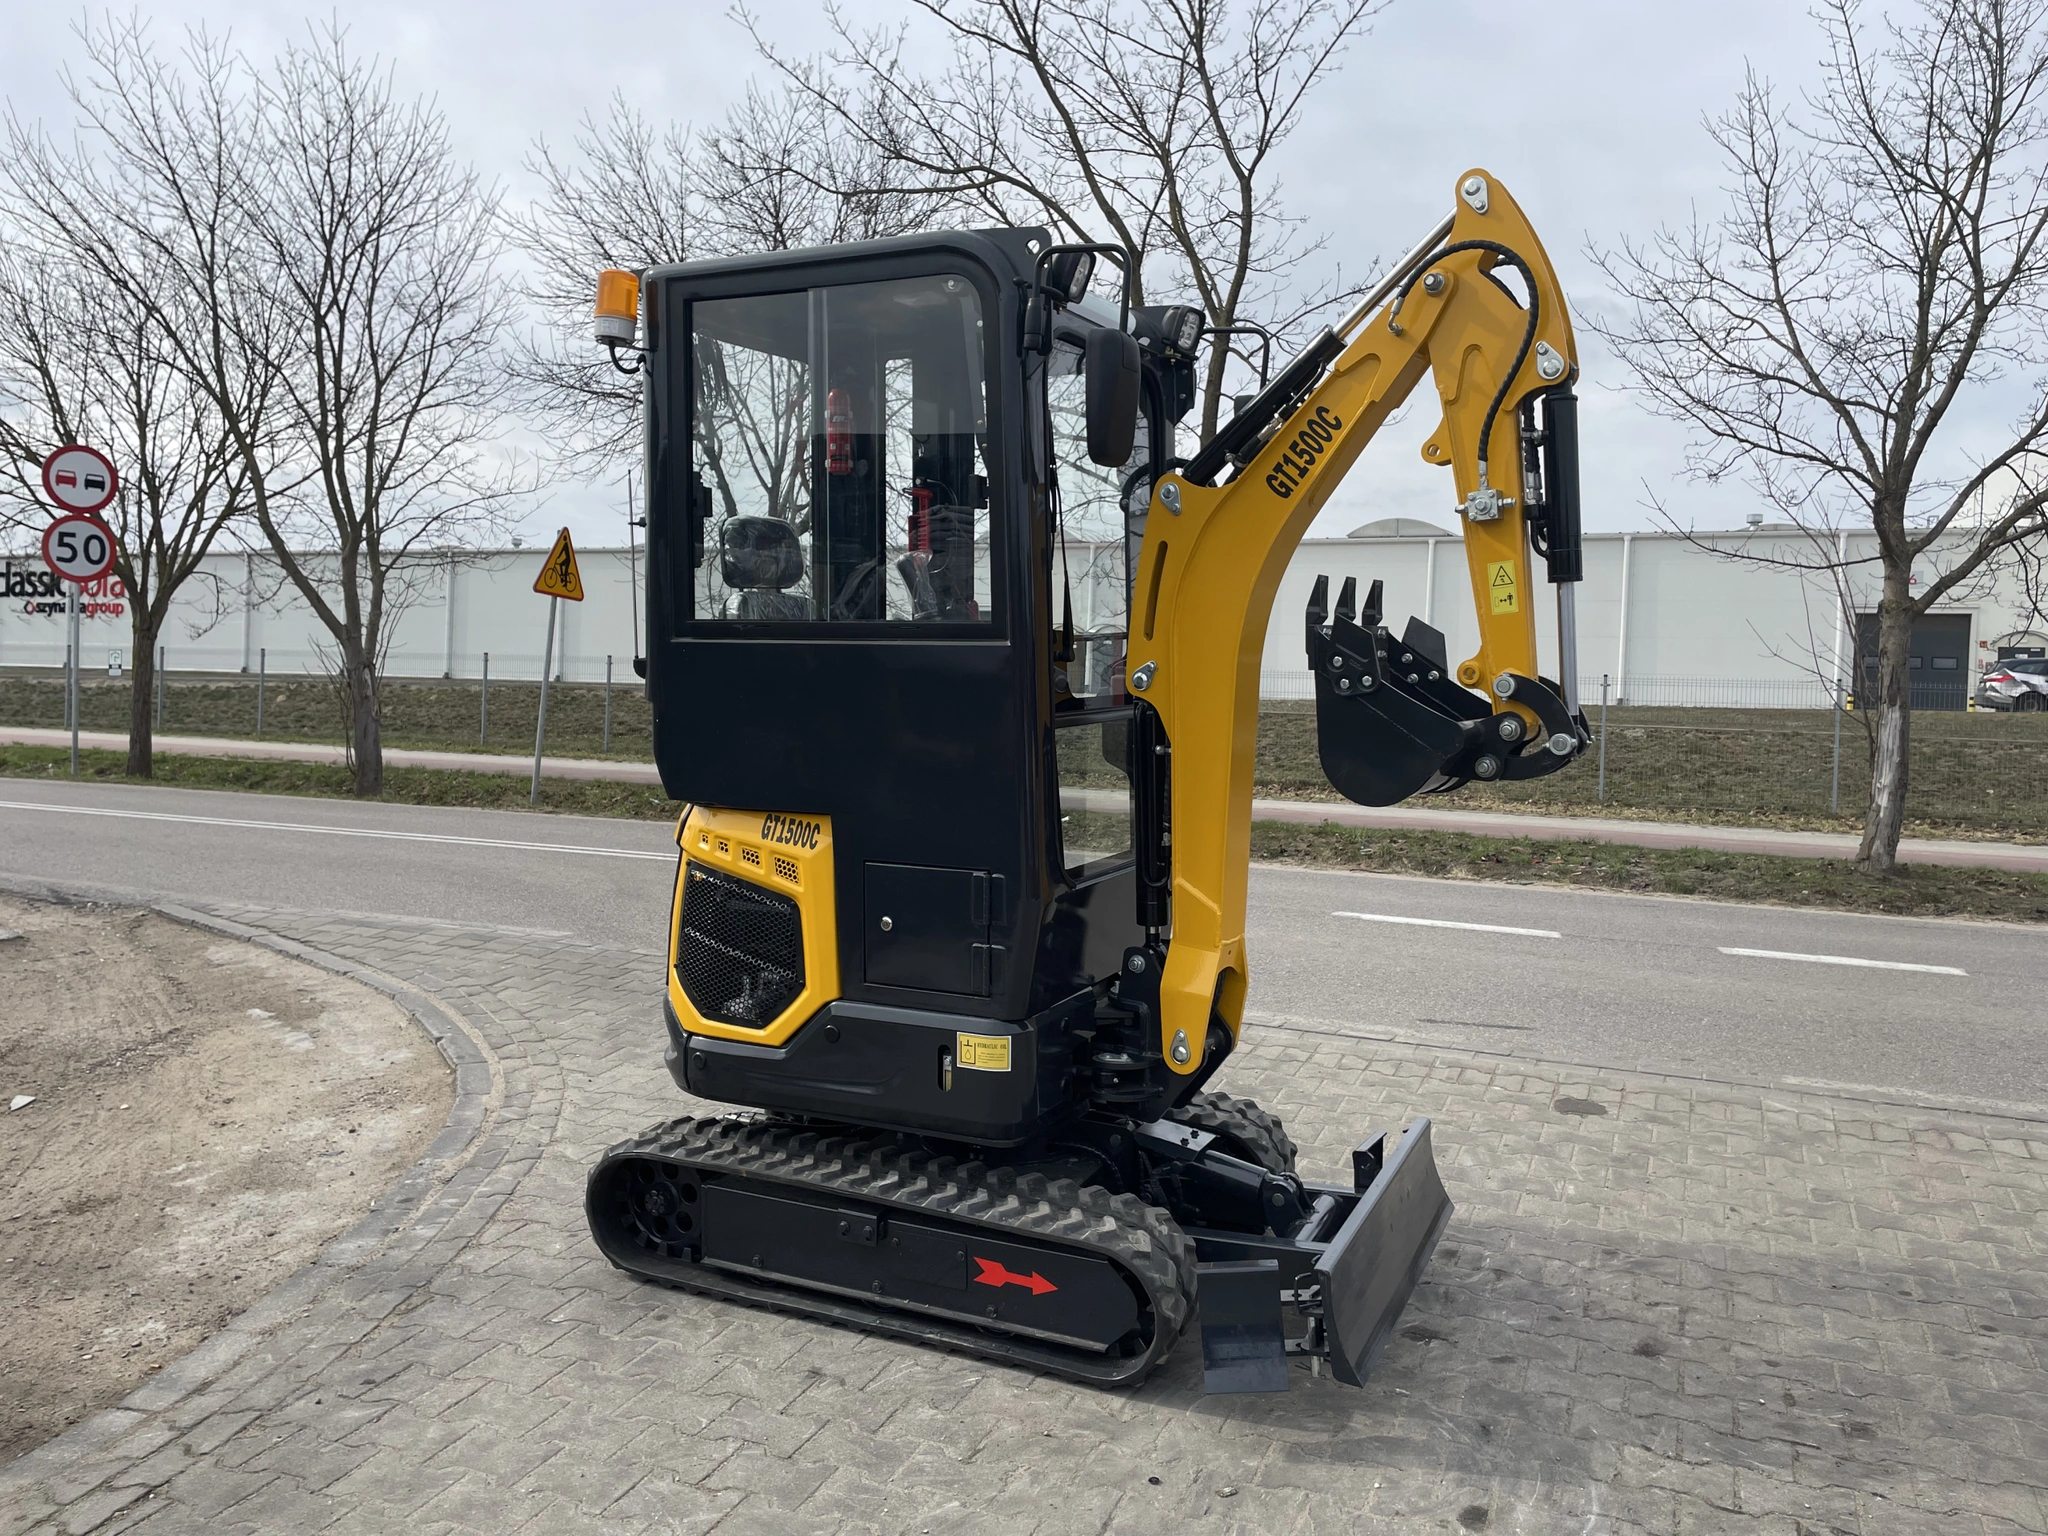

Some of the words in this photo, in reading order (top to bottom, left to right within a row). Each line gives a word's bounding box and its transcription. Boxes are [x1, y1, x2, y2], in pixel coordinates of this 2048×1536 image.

[1266, 406, 1342, 499] GT1500C
[56, 531, 106, 565] 50
[761, 813, 821, 850] GT1500C
